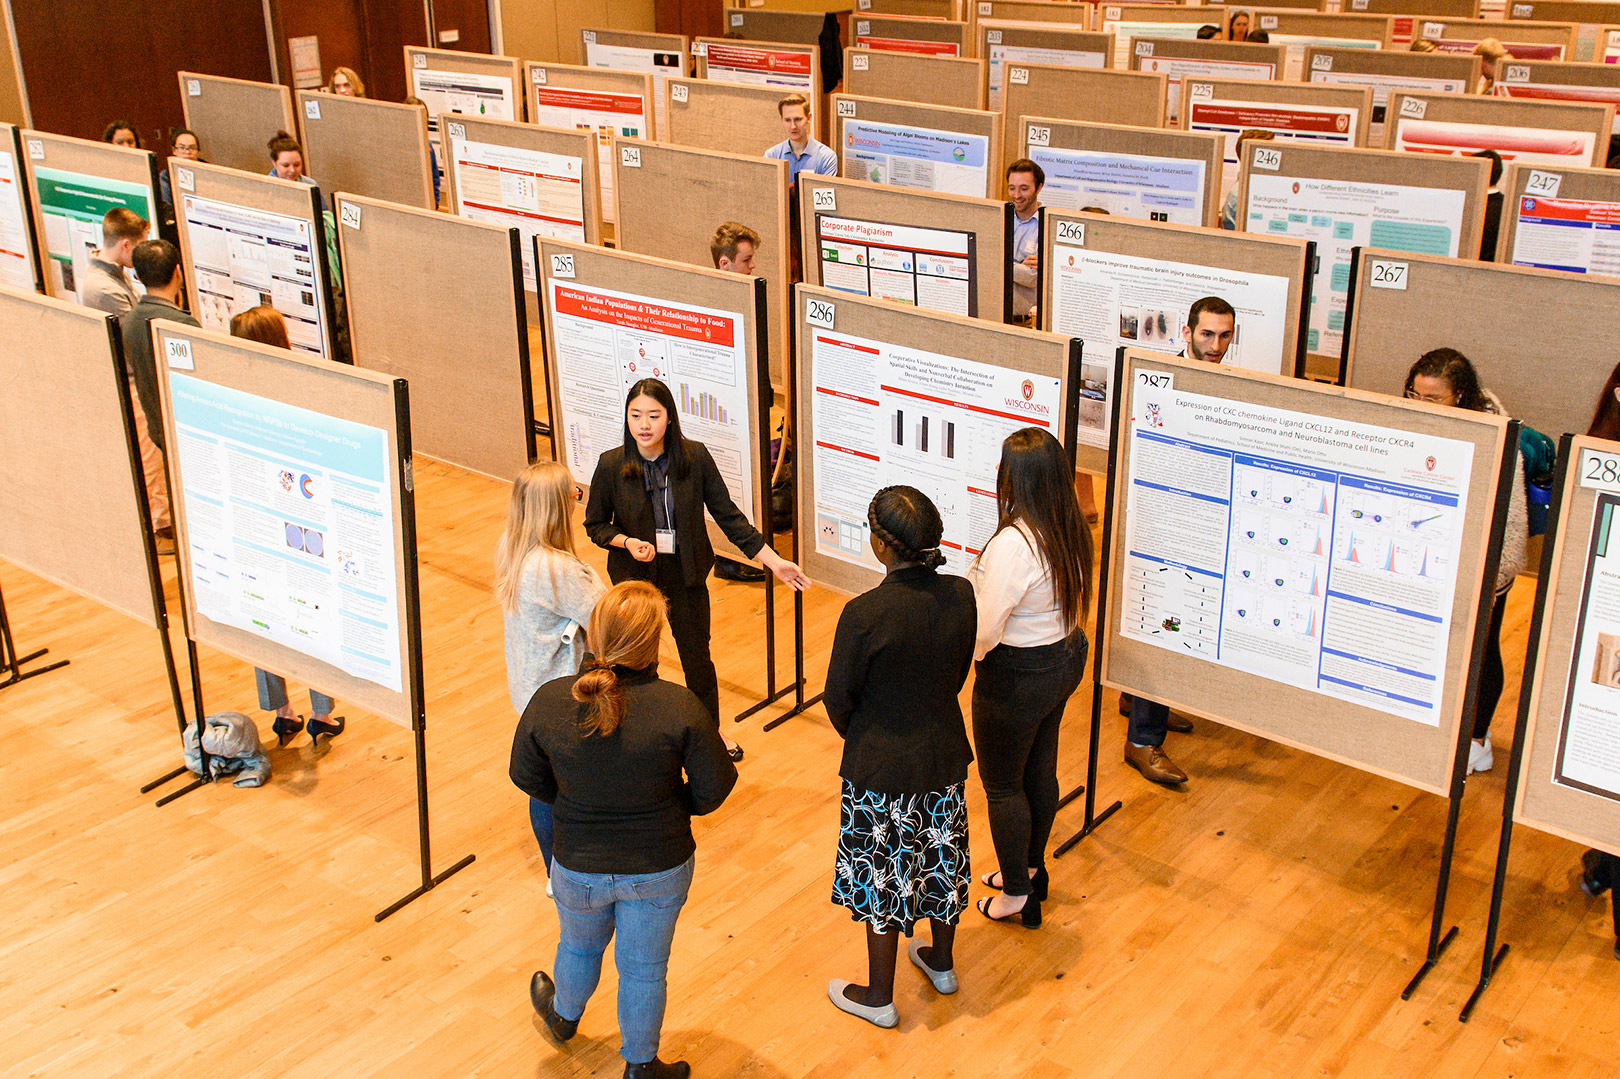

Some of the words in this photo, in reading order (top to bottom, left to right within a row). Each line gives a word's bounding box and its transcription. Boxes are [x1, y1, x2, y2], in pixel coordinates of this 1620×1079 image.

[988, 32, 1000, 40] 203
[1427, 26, 1439, 34] 185
[1137, 43, 1151, 53] 204
[854, 57, 867, 67] 223
[1315, 55, 1331, 66] 205
[533, 69, 544, 80] 242
[1012, 69, 1026, 79] 224
[1510, 68, 1527, 78] 206
[673, 85, 686, 98] 243
[1193, 85, 1211, 96] 225
[840, 102, 854, 114] 244
[1403, 100, 1423, 113] 226
[450, 124, 464, 137] 263
[858, 126, 877, 134] Predictive
[878, 128, 896, 136] Modeling
[936, 136, 956, 144] Madison's
[957, 138, 970, 146] Lakes
[1030, 128, 1048, 141] 245
[624, 149, 638, 162] 264
[1257, 150, 1278, 165] 246
[1074, 159, 1107, 168] Composition
[1119, 163, 1149, 172] Mechanical
[1162, 167, 1193, 176] Interaction
[1530, 174, 1558, 190] 247
[1320, 184, 1347, 192] Different
[1349, 186, 1378, 195] Ethnicities
[815, 191, 833, 205] 265
[1253, 195, 1288, 204] Background
[343, 206, 358, 225] 284
[1374, 206, 1399, 214] Purpose
[821, 220, 854, 233] Corporate
[856, 225, 892, 238] Plagiarism
[1059, 223, 1082, 240] 266
[554, 256, 572, 272] 285
[877, 256, 894, 266] python
[1108, 261, 1128, 269] improve
[1129, 264, 1153, 272] traumatic
[1186, 272, 1211, 280] outcomes
[1219, 277, 1249, 286] Drosophila
[1374, 265, 1404, 282] 267
[560, 290, 584, 301] American
[586, 294, 603, 304] Indian
[604, 298, 637, 312] Populations
[645, 306, 661, 316] Their
[662, 309, 699, 324] Relationship
[708, 318, 726, 328] Food:
[809, 301, 832, 323] 286
[588, 306, 608, 315] Analysis
[624, 312, 643, 322] Impacts
[650, 317, 681, 329] Generational
[683, 323, 702, 333] Trauma
[170, 342, 187, 357] 300
[889, 353, 916, 363] Cooperative
[916, 358, 949, 370] Visualizations:
[950, 365, 959, 373] The
[960, 368, 988, 379] Intersection
[889, 361, 905, 370] Spatial
[929, 369, 952, 379] Nonverbal
[953, 374, 985, 386] Collaboration
[904, 372, 929, 382] Developing
[930, 377, 954, 387] Chemistry
[955, 383, 976, 391] Intuition
[1004, 397, 1049, 414] WISCONSIN
[1175, 398, 1212, 412] Expression
[1223, 407, 1236, 415] CXC
[1238, 409, 1278, 423] chemokine
[1279, 416, 1303, 428] Ligand
[1305, 422, 1333, 434] CXCL12
[1335, 427, 1349, 436] and
[1352, 430, 1386, 444] Receptor
[1389, 436, 1414, 448] CXCR4
[284, 421, 290, 429] to
[290, 423, 313, 437] Develop
[314, 430, 341, 443] Designer
[342, 436, 361, 450] Drugs
[1205, 415, 1277, 435] Rhabdomyosarcoma
[1278, 428, 1293, 437] and
[1295, 432, 1352, 450] Neuroblastoma
[1355, 443, 1369, 452] cell
[1370, 446, 1389, 456] lines
[1187, 432, 1210, 440] Department
[1216, 437, 1235, 446] Pediatrics,
[1256, 445, 1275, 453] Medicine
[1298, 453, 1313, 461] Health,
[1315, 457, 1335, 465] University
[1270, 464, 1294, 472] Expression
[1586, 457, 1620, 483] 28
[1168, 487, 1191, 497] Introduction
[1383, 487, 1408, 496] Expression
[1369, 601, 1397, 612] Conclusions
[1362, 686, 1387, 696] References
[1579, 702, 1617, 716] Introduction
